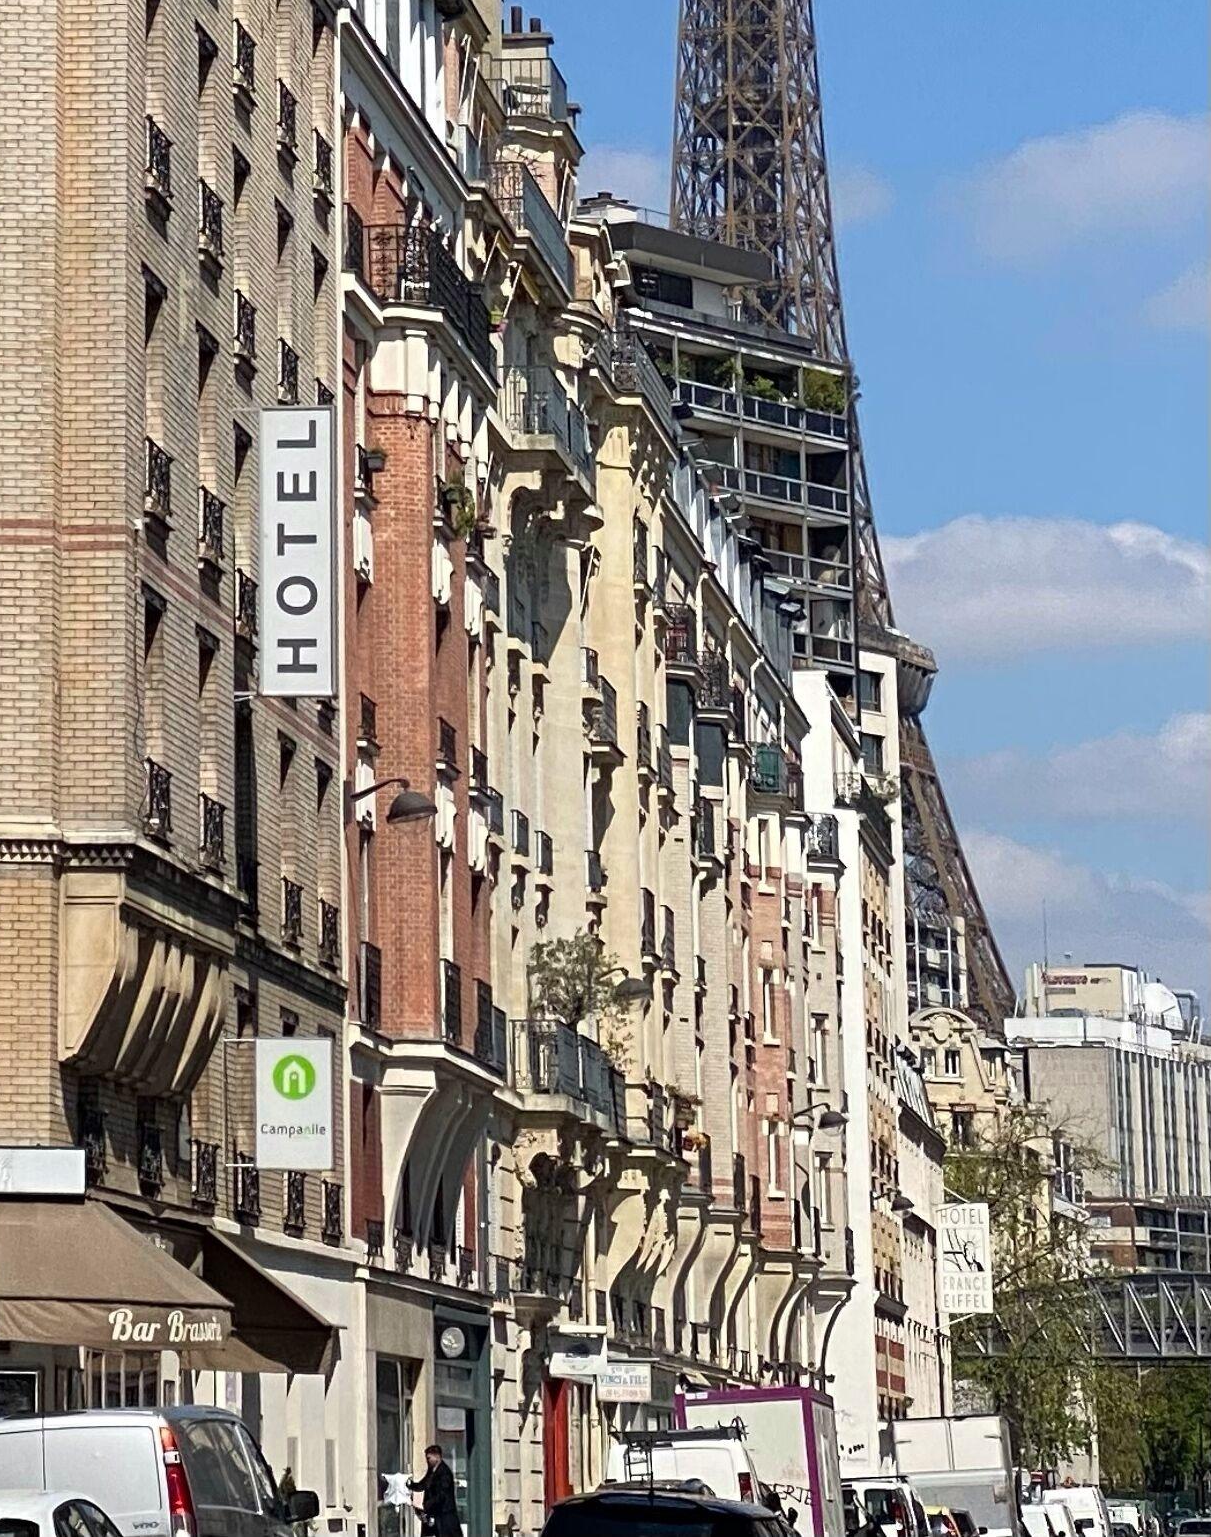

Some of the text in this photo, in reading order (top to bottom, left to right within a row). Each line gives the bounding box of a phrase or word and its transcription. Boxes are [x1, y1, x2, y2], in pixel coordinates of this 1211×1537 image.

[276, 419, 318, 674] HOTEL
[260, 1123, 327, 1139] Campanile
[940, 1208, 985, 1225] HOTEL
[942, 1276, 988, 1292] FRANCE
[943, 1294, 989, 1309] EIFFEL
[108, 1308, 161, 1341] Bar
